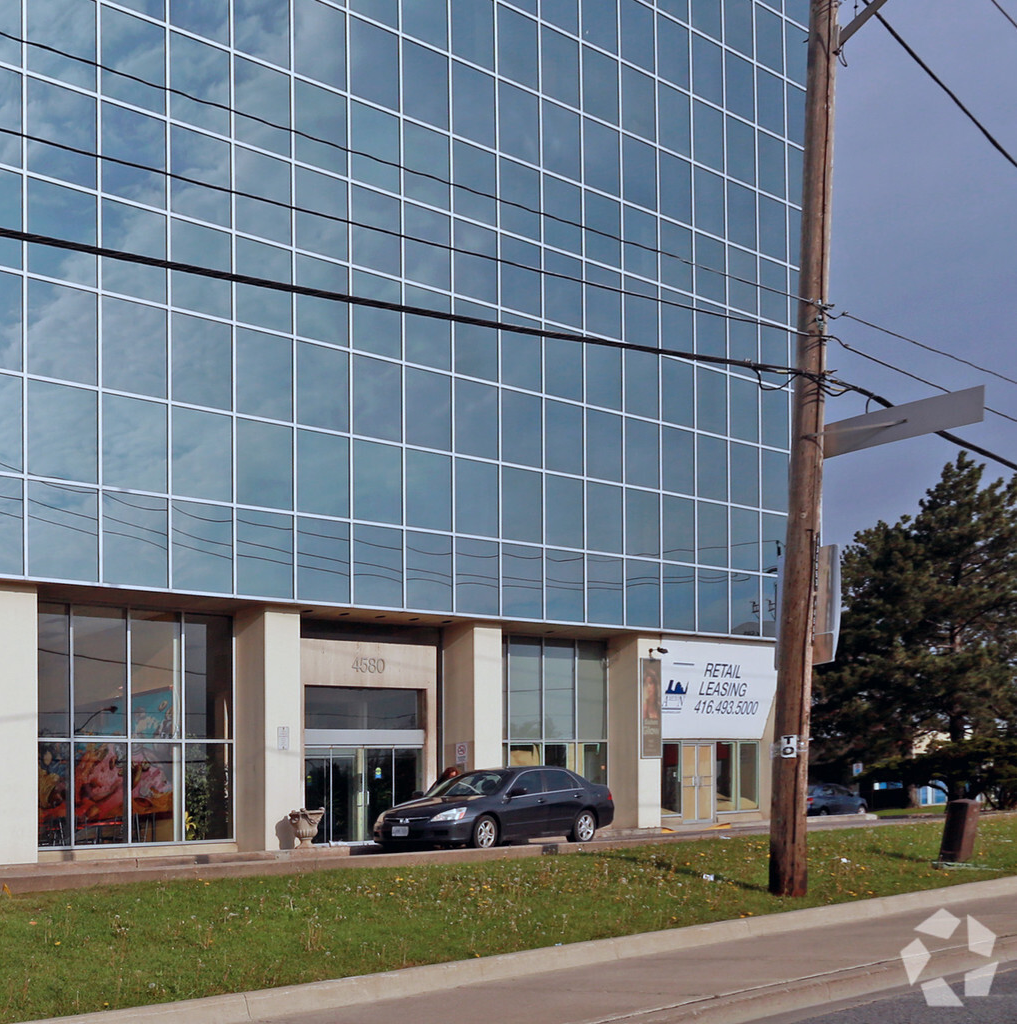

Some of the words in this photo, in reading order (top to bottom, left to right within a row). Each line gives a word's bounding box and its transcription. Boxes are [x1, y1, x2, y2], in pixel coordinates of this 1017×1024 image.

[351, 657, 386, 673] 4580
[704, 663, 741, 679] RETAIL
[699, 681, 748, 697] LEASING
[694, 700, 759, 716] 416.493.5000
